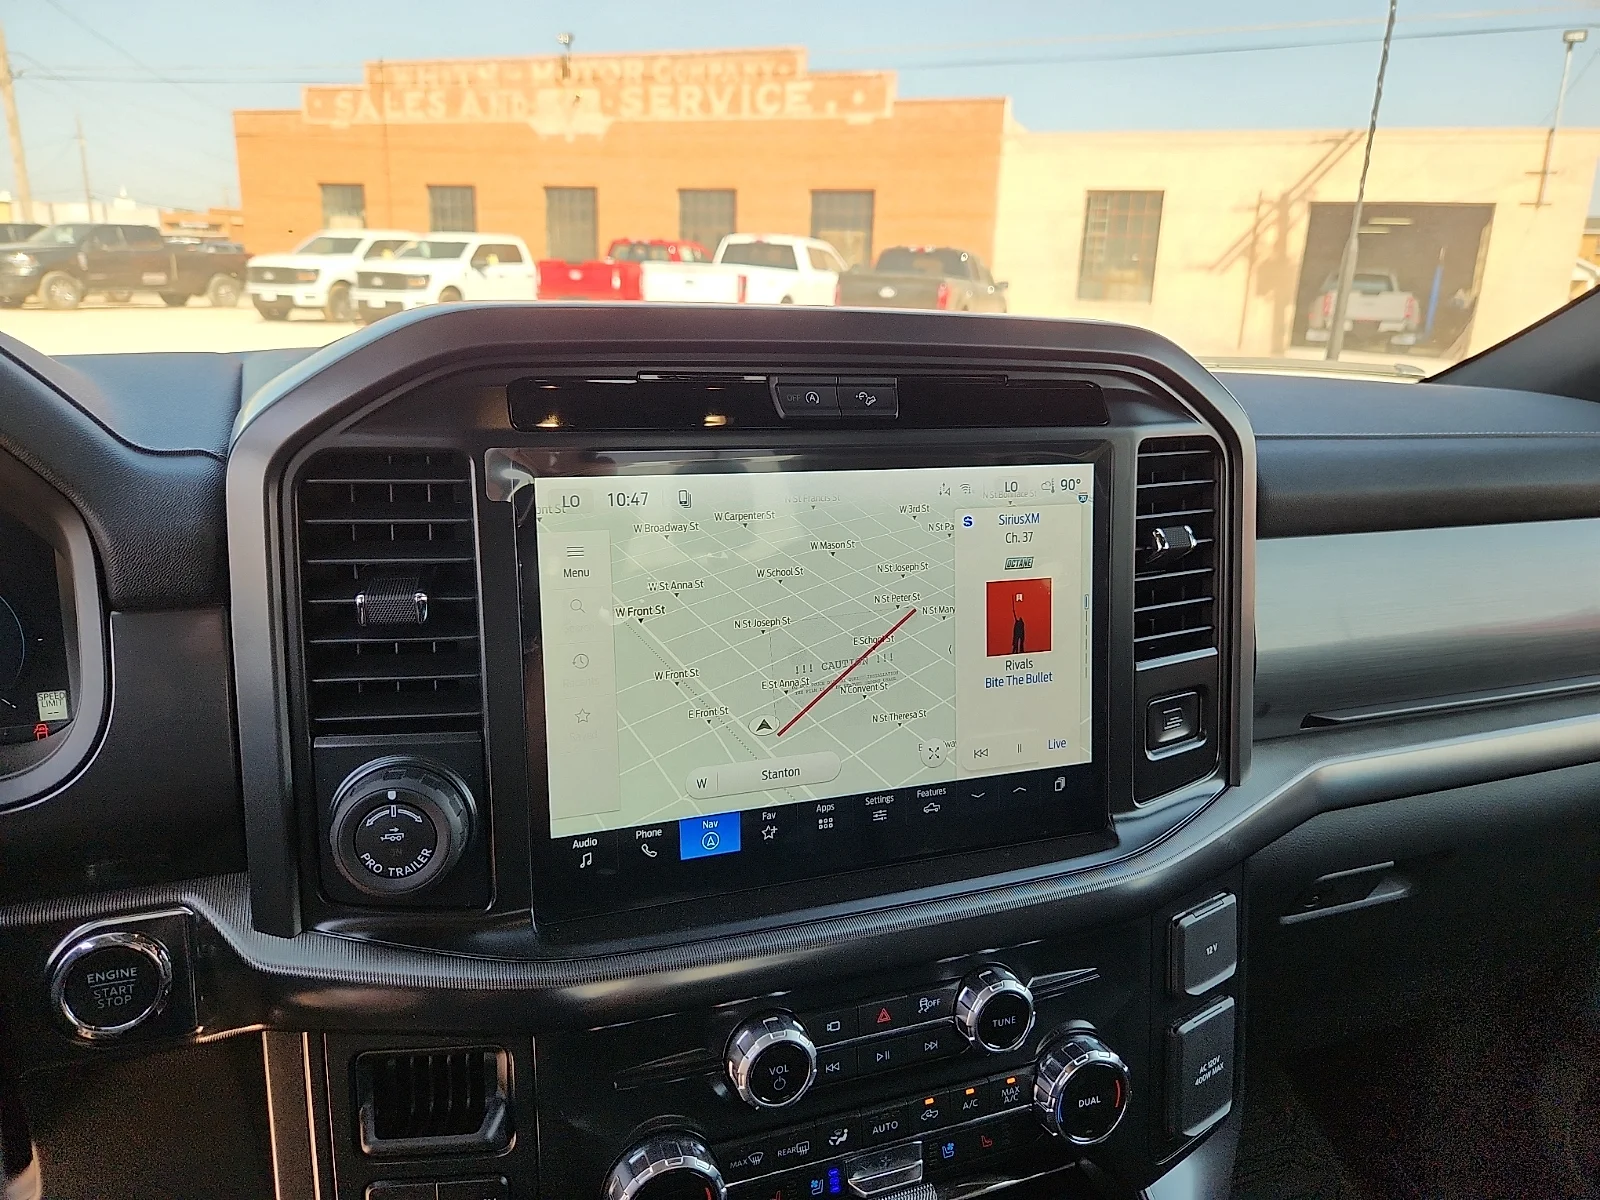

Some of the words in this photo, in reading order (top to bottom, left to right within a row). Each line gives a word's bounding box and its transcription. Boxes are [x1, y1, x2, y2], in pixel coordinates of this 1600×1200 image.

[333, 90, 447, 121] SALES
[619, 81, 814, 117] SERVICE
[1005, 481, 1018, 492] LO
[1061, 479, 1081, 491] 90°
[562, 495, 580, 508] LO
[607, 491, 649, 507] 10:47
[899, 505, 908, 513] W
[909, 504, 920, 513] 3rd
[922, 504, 930, 512] St
[713, 513, 724, 521] W
[725, 511, 764, 523] Carpenter
[765, 510, 776, 519] St
[998, 513, 1040, 525] SiriusXM
[633, 524, 643, 533] W
[644, 523, 687, 533] Broadway
[690, 522, 700, 531] St
[928, 523, 934, 531] N
[935, 523, 944, 531] St
[1005, 532, 1021, 543] Ch.
[1023, 532, 1034, 543] 37
[810, 542, 818, 550] W
[820, 541, 845, 550] Mason
[847, 540, 855, 548] St
[877, 564, 883, 572] N
[885, 564, 893, 572] St
[894, 562, 920, 572] Joseph
[920, 562, 929, 570] St
[1005, 557, 1033, 569] OCTANE
[563, 568, 590, 578] Menu
[757, 569, 767, 578] W
[767, 568, 794, 577] School
[794, 567, 804, 576] St
[648, 582, 657, 591] W
[659, 582, 669, 591] St
[671, 581, 693, 590] Anna
[694, 580, 704, 589] St
[881, 595, 890, 603] St
[891, 594, 911, 602] Peter
[912, 593, 921, 601] St
[615, 608, 626, 617] W
[627, 606, 653, 616] Front
[655, 605, 665, 615] St
[929, 606, 938, 614] St
[939, 606, 955, 614] Mary
[734, 620, 741, 628] N
[742, 620, 751, 628] St
[752, 618, 780, 629] Joseph
[782, 617, 791, 625] St
[853, 637, 858, 645] E
[859, 636, 885, 645] Schol
[821, 657, 869, 671] CAUTIN
[1005, 658, 1033, 671] Rivals
[655, 672, 664, 680] W
[665, 670, 688, 679] Front
[689, 669, 699, 677] St
[985, 677, 1004, 688] Bite
[1006, 675, 1024, 686] The
[1025, 672, 1053, 684] Bullet
[761, 682, 767, 690] E
[768, 681, 777, 690] St
[779, 680, 799, 688] Anna
[801, 677, 810, 686] St
[840, 687, 847, 695] N
[848, 684, 878, 693] Convent
[879, 682, 888, 690] St
[38, 692, 65, 701] SPEED
[41, 700, 62, 708] LIMIT
[688, 710, 693, 719] E
[695, 708, 718, 718] Front
[719, 707, 729, 716] St
[872, 714, 879, 723] N
[880, 714, 889, 722] St
[890, 711, 916, 721] Theresa
[917, 710, 926, 719] St
[1048, 739, 1067, 750] Live
[696, 778, 707, 789] W
[761, 767, 800, 780] Stanton
[916, 787, 947, 798] Features
[865, 794, 894, 806] Settings
[816, 803, 835, 813] Apps
[762, 811, 776, 821] Fav
[702, 819, 719, 829] Nav
[635, 828, 662, 840] Phone
[572, 837, 598, 850] Audio
[360, 852, 383, 874] PRO
[388, 848, 433, 877] TRAILER
[1206, 943, 1218, 956] 12V
[86, 967, 138, 984] ENGINE
[94, 984, 134, 999] START
[97, 994, 132, 1009] STOP
[928, 998, 941, 1007] OFF
[993, 1016, 1017, 1027] TUNE
[769, 1064, 790, 1076] VOL
[1199, 1062, 1208, 1074] AC
[1208, 1054, 1221, 1069] 120V
[1195, 1071, 1212, 1086] 400W
[1211, 1062, 1224, 1077] MAX
[1001, 1086, 1020, 1097] MAX
[962, 1099, 979, 1111] A/C
[1003, 1093, 1019, 1105] A/C
[1078, 1096, 1101, 1108] DUAL
[872, 1120, 899, 1135] AUTO
[778, 1147, 796, 1158] REAR
[730, 1158, 748, 1169] MAX
